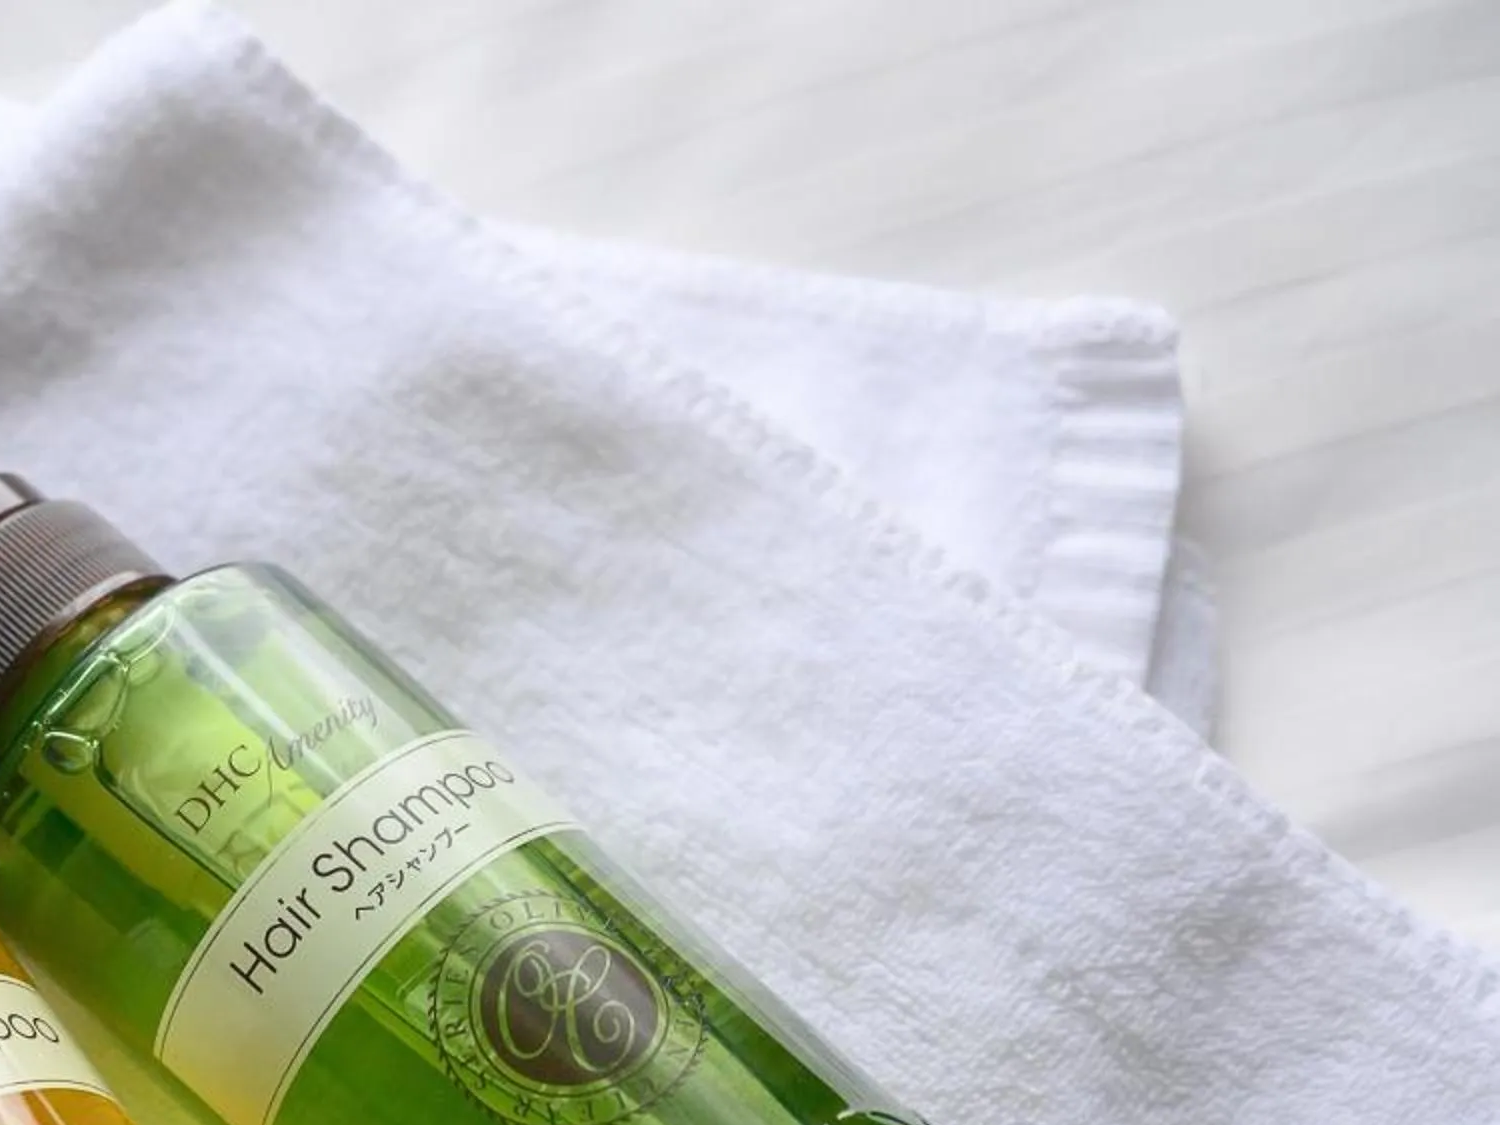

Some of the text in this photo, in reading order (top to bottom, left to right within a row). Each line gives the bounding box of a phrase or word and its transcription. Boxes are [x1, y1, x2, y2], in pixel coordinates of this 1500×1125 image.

[174, 692, 380, 835] DHC Amenity
[229, 760, 516, 994] Hair Shampoo
